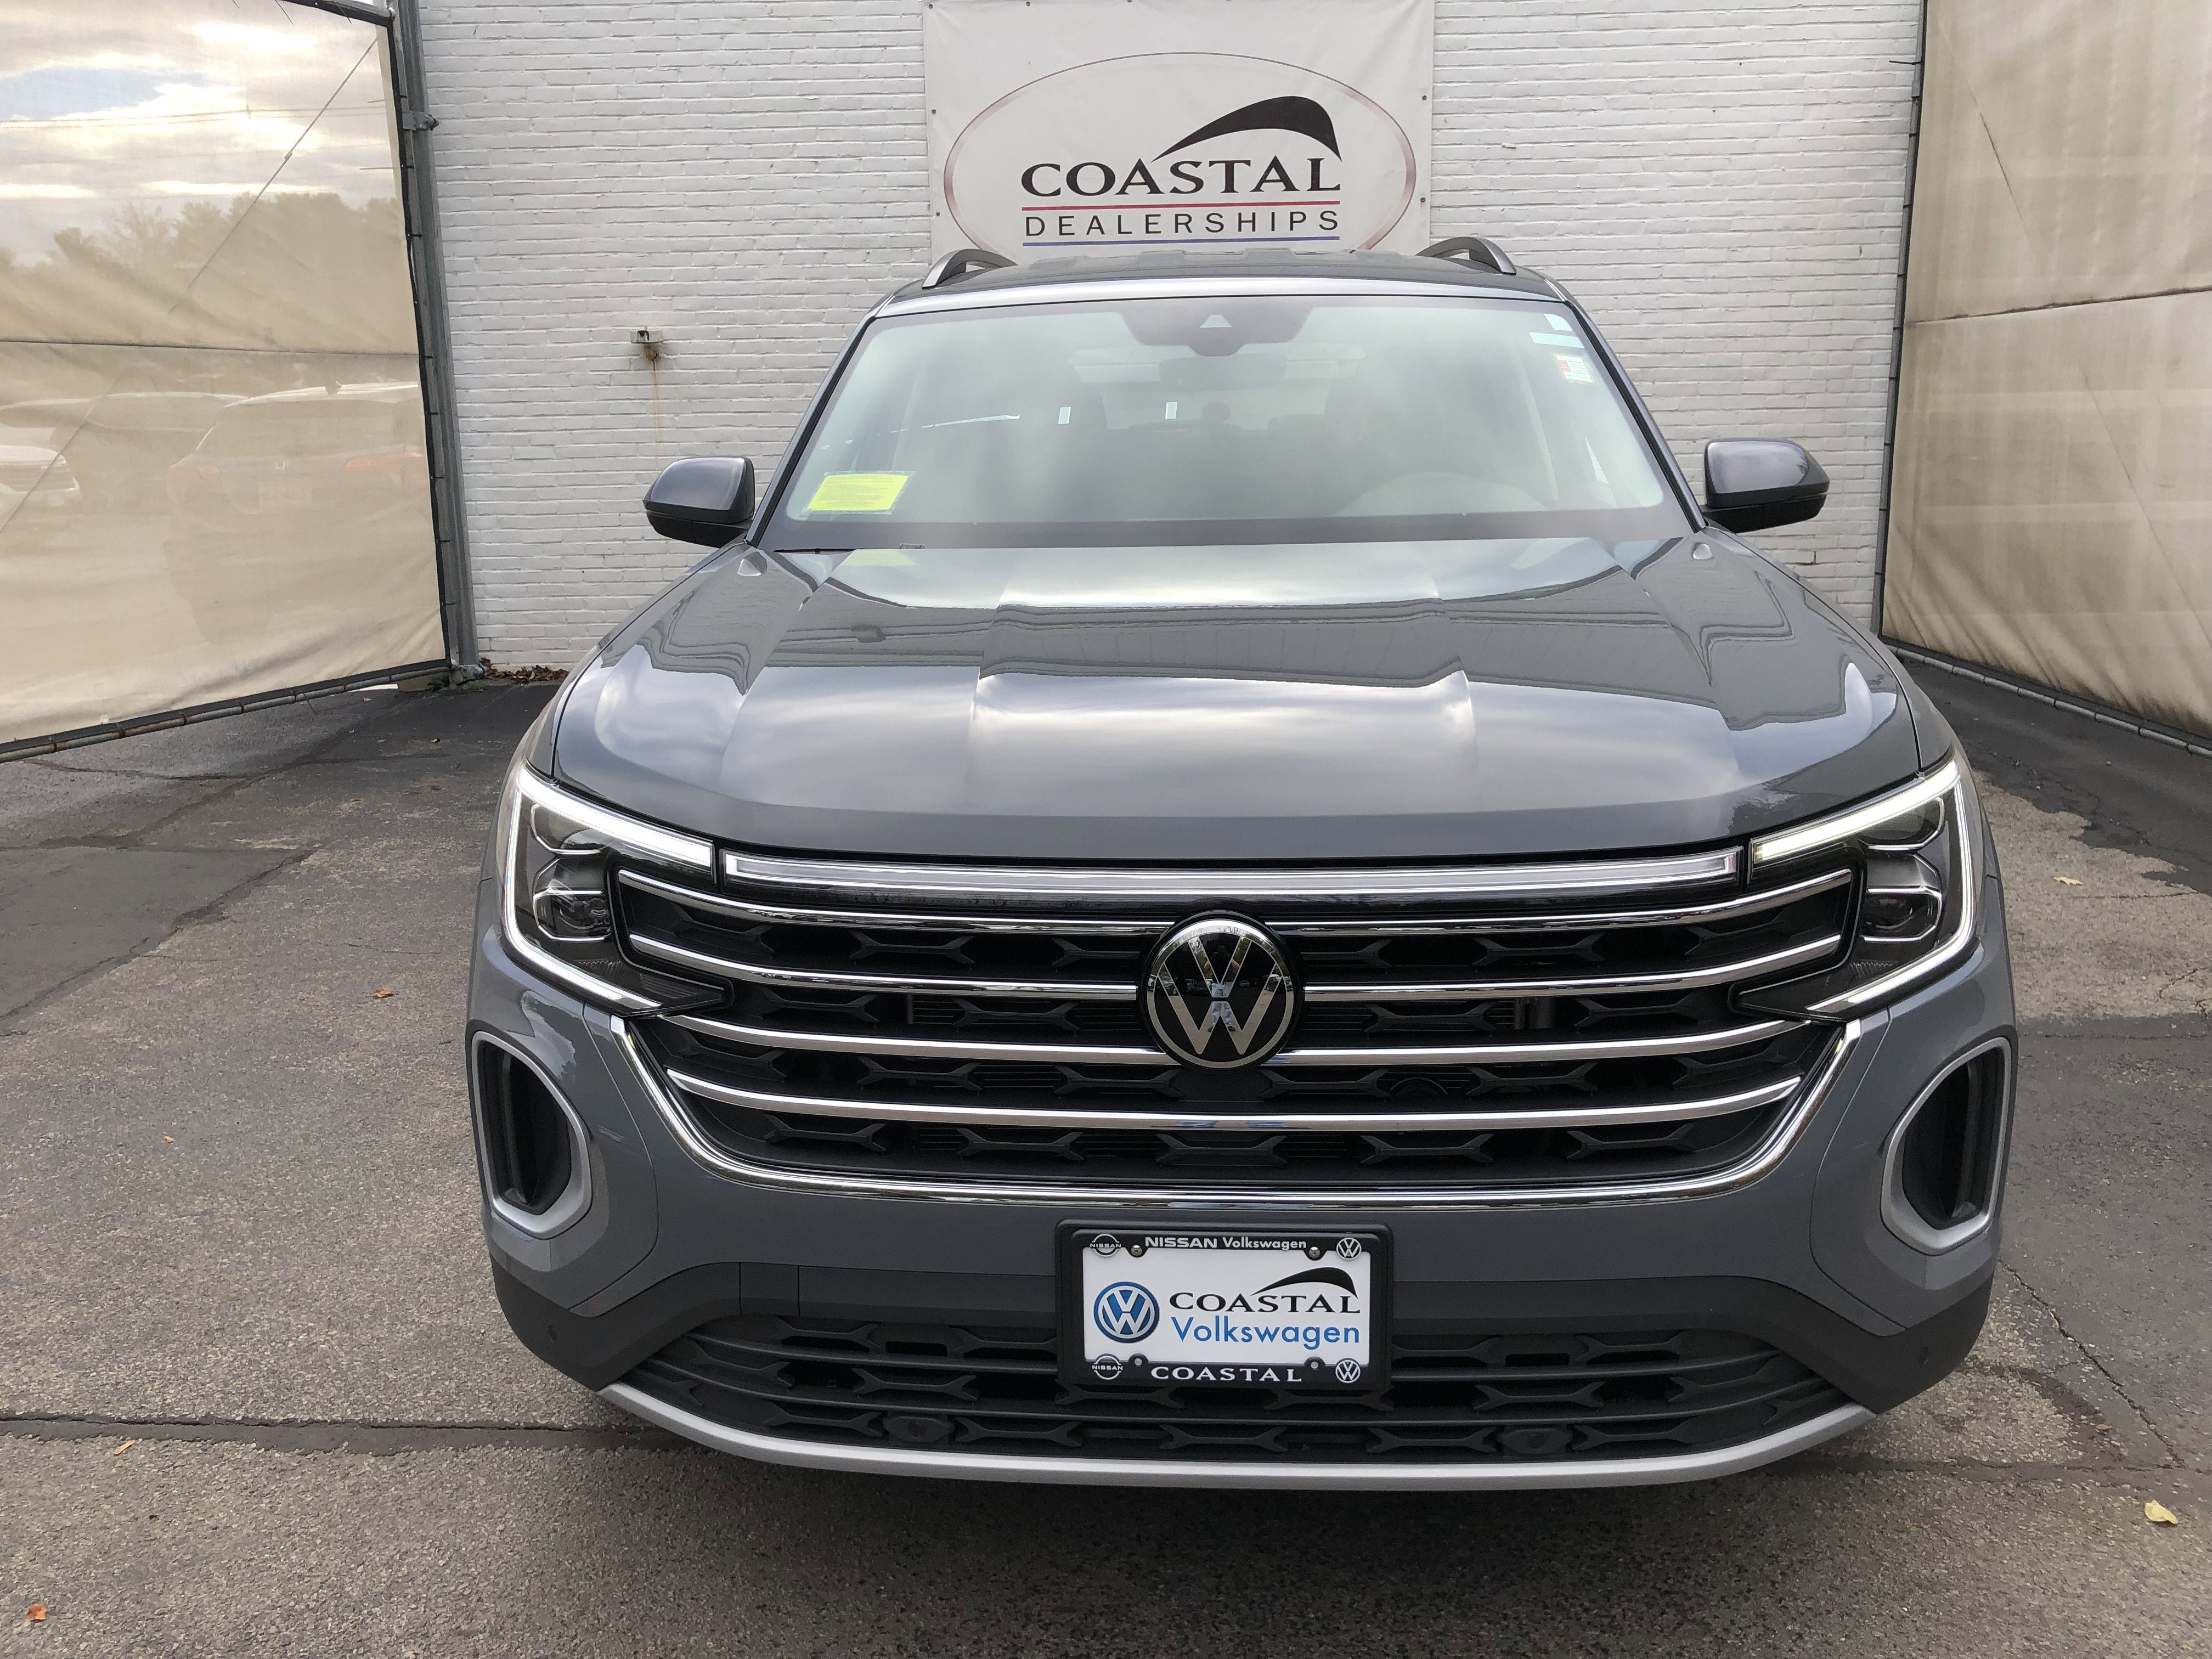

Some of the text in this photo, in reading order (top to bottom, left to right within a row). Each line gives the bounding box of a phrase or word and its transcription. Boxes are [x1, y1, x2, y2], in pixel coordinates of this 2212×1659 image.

[1021, 155, 1341, 197] COASTAL
[1025, 210, 1339, 237] DEALERSHIPS
[1153, 927, 1288, 1059] VW
[1145, 1237, 1307, 1251] NISSAN Volkswagen
[1337, 1238, 1361, 1259] VW
[1098, 1285, 1155, 1339] VW
[1169, 1291, 1361, 1314] COASTAL
[1170, 1315, 1359, 1350] Volkswagen
[1150, 1366, 1302, 1383] COASTAL
[1336, 1361, 1361, 1383] VW
